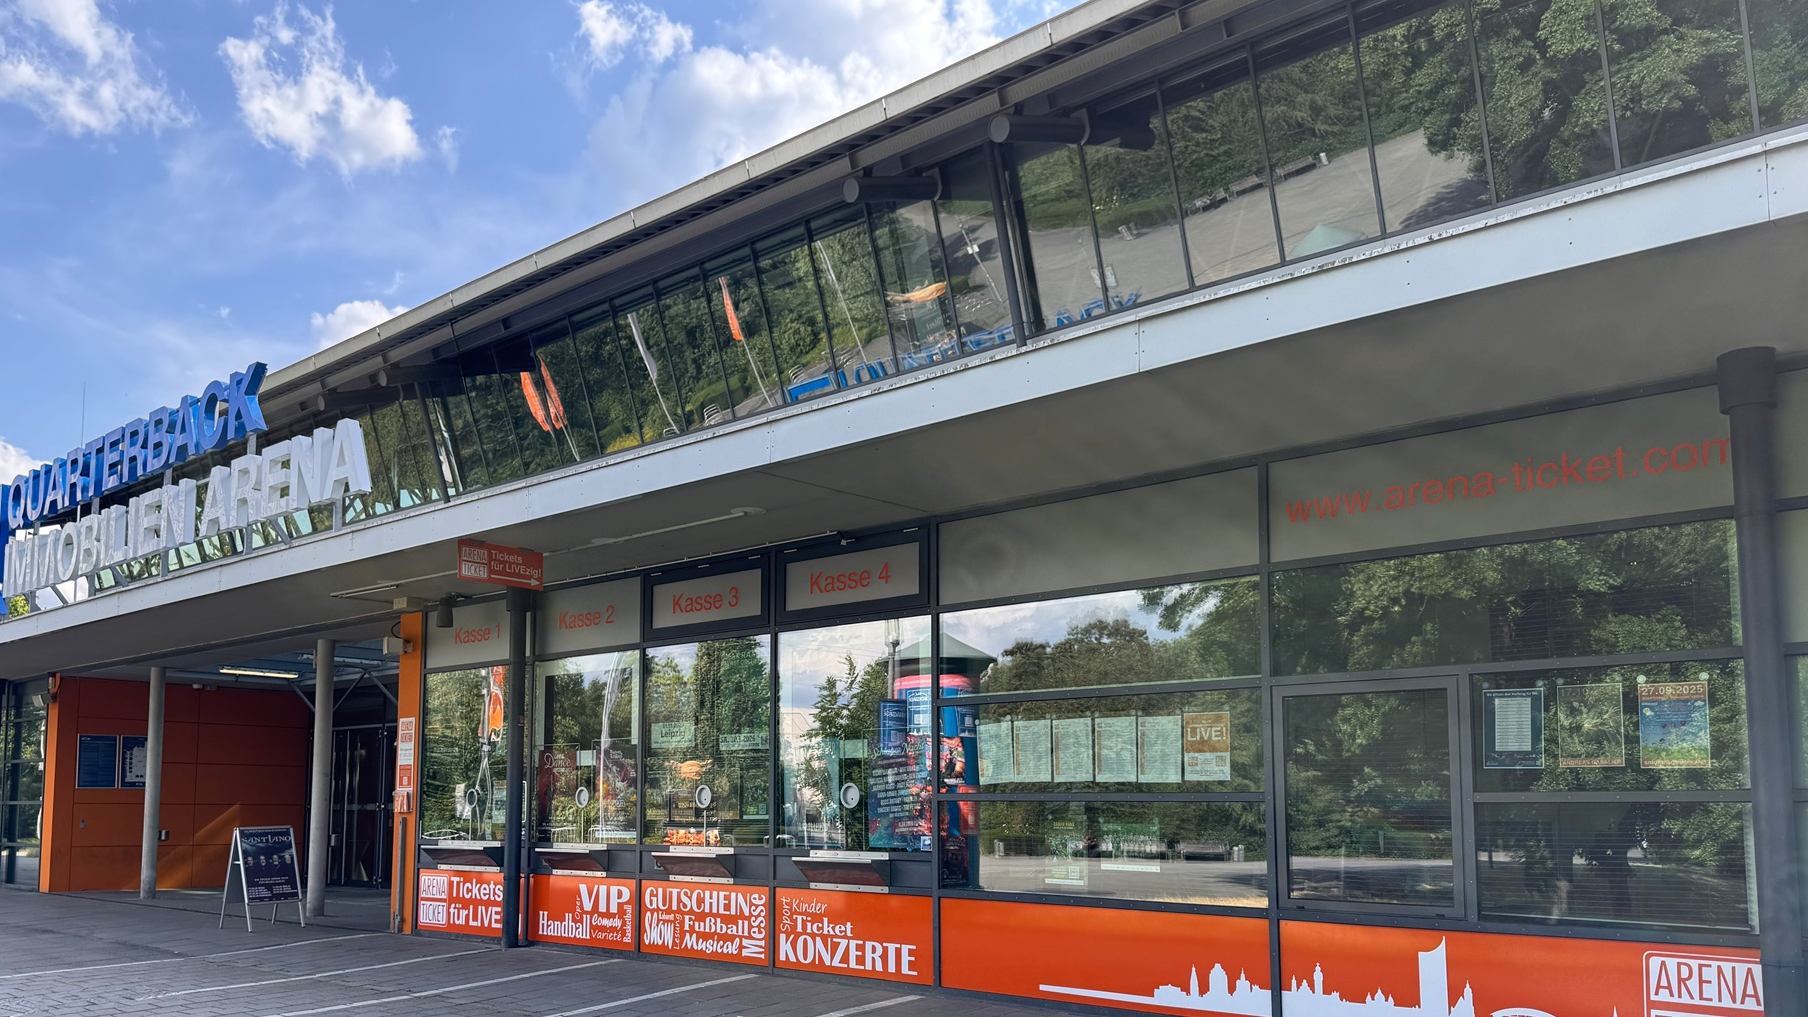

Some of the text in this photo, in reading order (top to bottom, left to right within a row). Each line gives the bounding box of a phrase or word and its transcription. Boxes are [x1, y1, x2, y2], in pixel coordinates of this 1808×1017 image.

[7, 360, 269, 529] QUARTERBACK
[1285, 437, 1731, 523] www.arena-ticket.com
[2, 417, 372, 598] IMMOBILIEN ARENA
[463, 547, 487, 562] ARENA
[490, 550, 523, 564] Tickets
[463, 562, 487, 578] TICKET
[490, 560, 541, 579] für LIVEzig!
[809, 562, 891, 594] Kasse 4
[672, 586, 739, 614] Kasse 3
[559, 604, 615, 630] Kasse 2
[454, 622, 501, 645] Kasse 1
[1641, 685, 1703, 696] 27.09.2025
[660, 728, 686, 740] Leipzig
[1187, 727, 1227, 741] LIVE!
[421, 876, 447, 897] ARENA
[450, 876, 503, 902] Tickets
[579, 883, 631, 914] VIP
[421, 902, 446, 924] TICKET
[644, 886, 751, 916] GUTSCHEIN
[780, 896, 791, 932] Sport
[792, 897, 828, 914] Kinder
[449, 903, 503, 929] für LIVE
[538, 910, 590, 940] Handball
[592, 913, 623, 930] Comedy
[623, 904, 632, 943] Basketball
[683, 914, 749, 937] Fußball
[742, 893, 766, 960] Messe
[793, 915, 853, 937] Ticket
[591, 929, 622, 941] Varieté
[643, 911, 674, 950] Show
[673, 914, 682, 950] Lesung
[681, 933, 740, 955] Musical
[779, 933, 918, 976] KONZERTE
[1654, 959, 1762, 1007] ARENA
